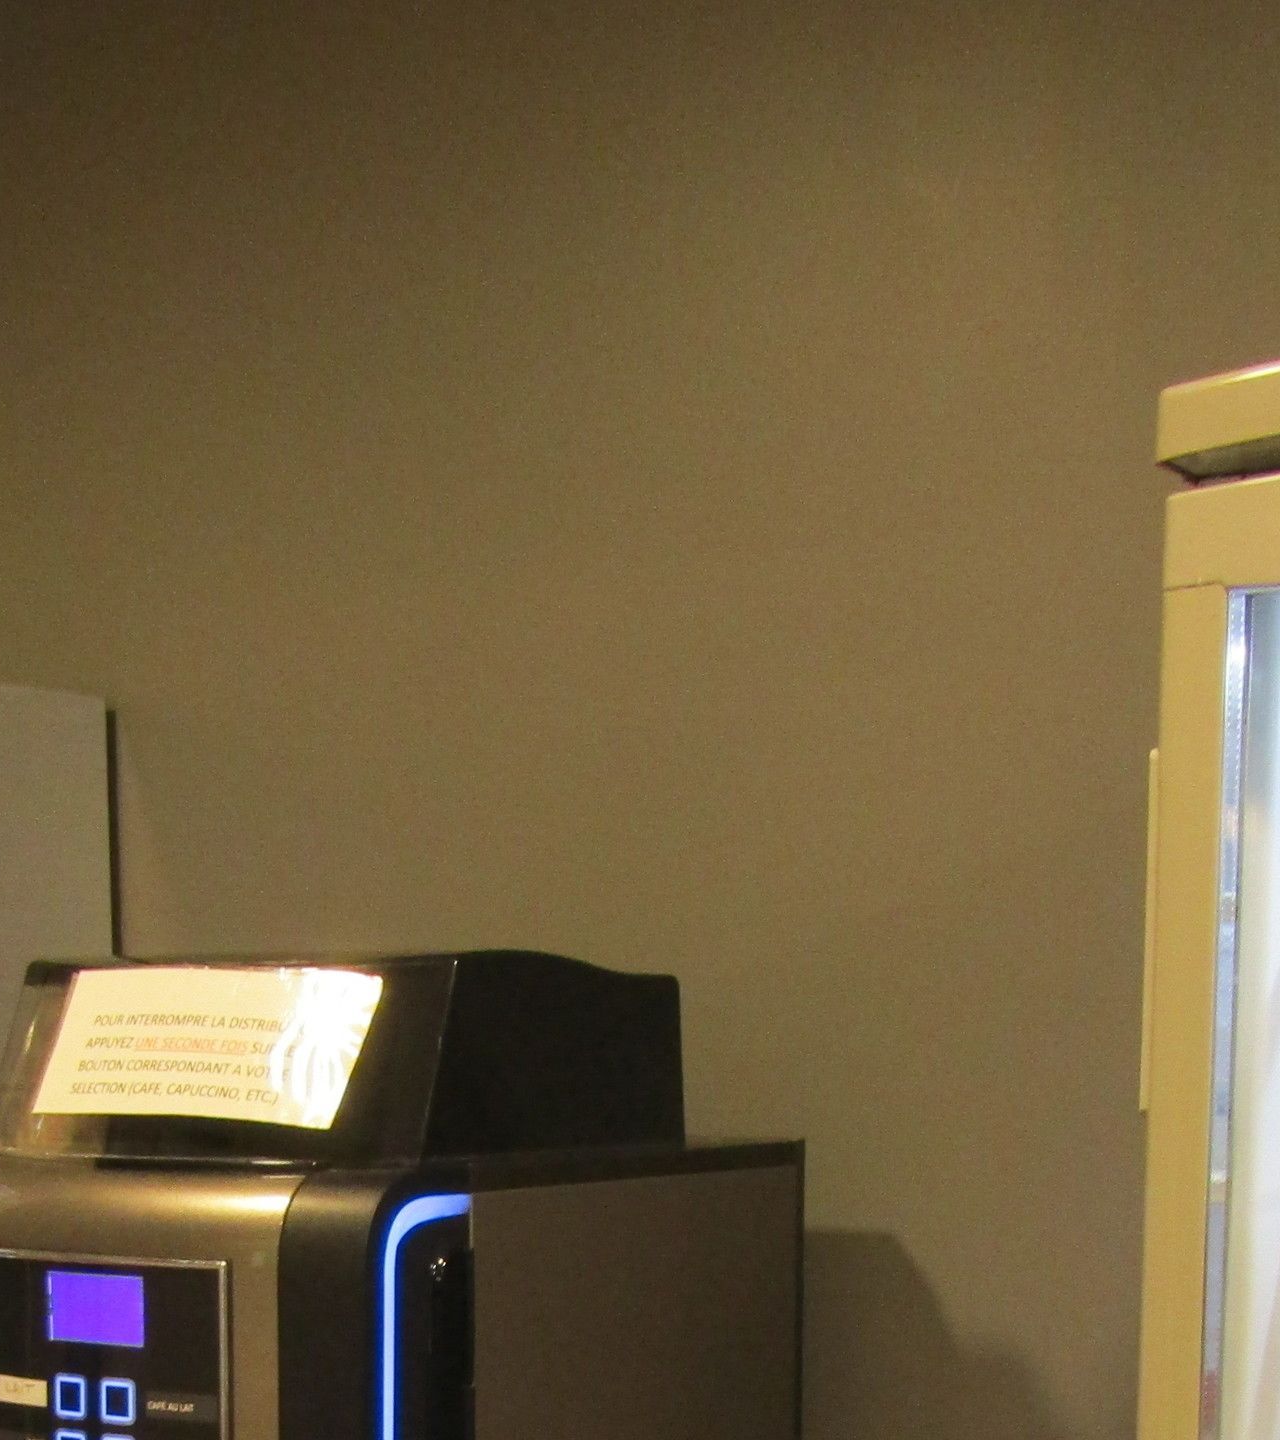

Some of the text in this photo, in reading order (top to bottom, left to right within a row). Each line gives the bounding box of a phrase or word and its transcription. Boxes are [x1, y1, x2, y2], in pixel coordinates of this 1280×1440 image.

[94, 1014, 287, 1034] POUR INTERROMPRE LA DISTRIBU
[85, 1037, 135, 1049] APPUYEZ
[135, 1038, 159, 1050] UNE
[162, 1038, 218, 1052] SECONDE
[221, 1039, 248, 1053] FOIS
[77, 1059, 290, 1078] BOUTON CORRESPONDANT A VOTE
[70, 1082, 127, 1094] SELECTION
[127, 1083, 163, 1096] (CAFE,
[166, 1084, 241, 1101] CAPUCCINO,
